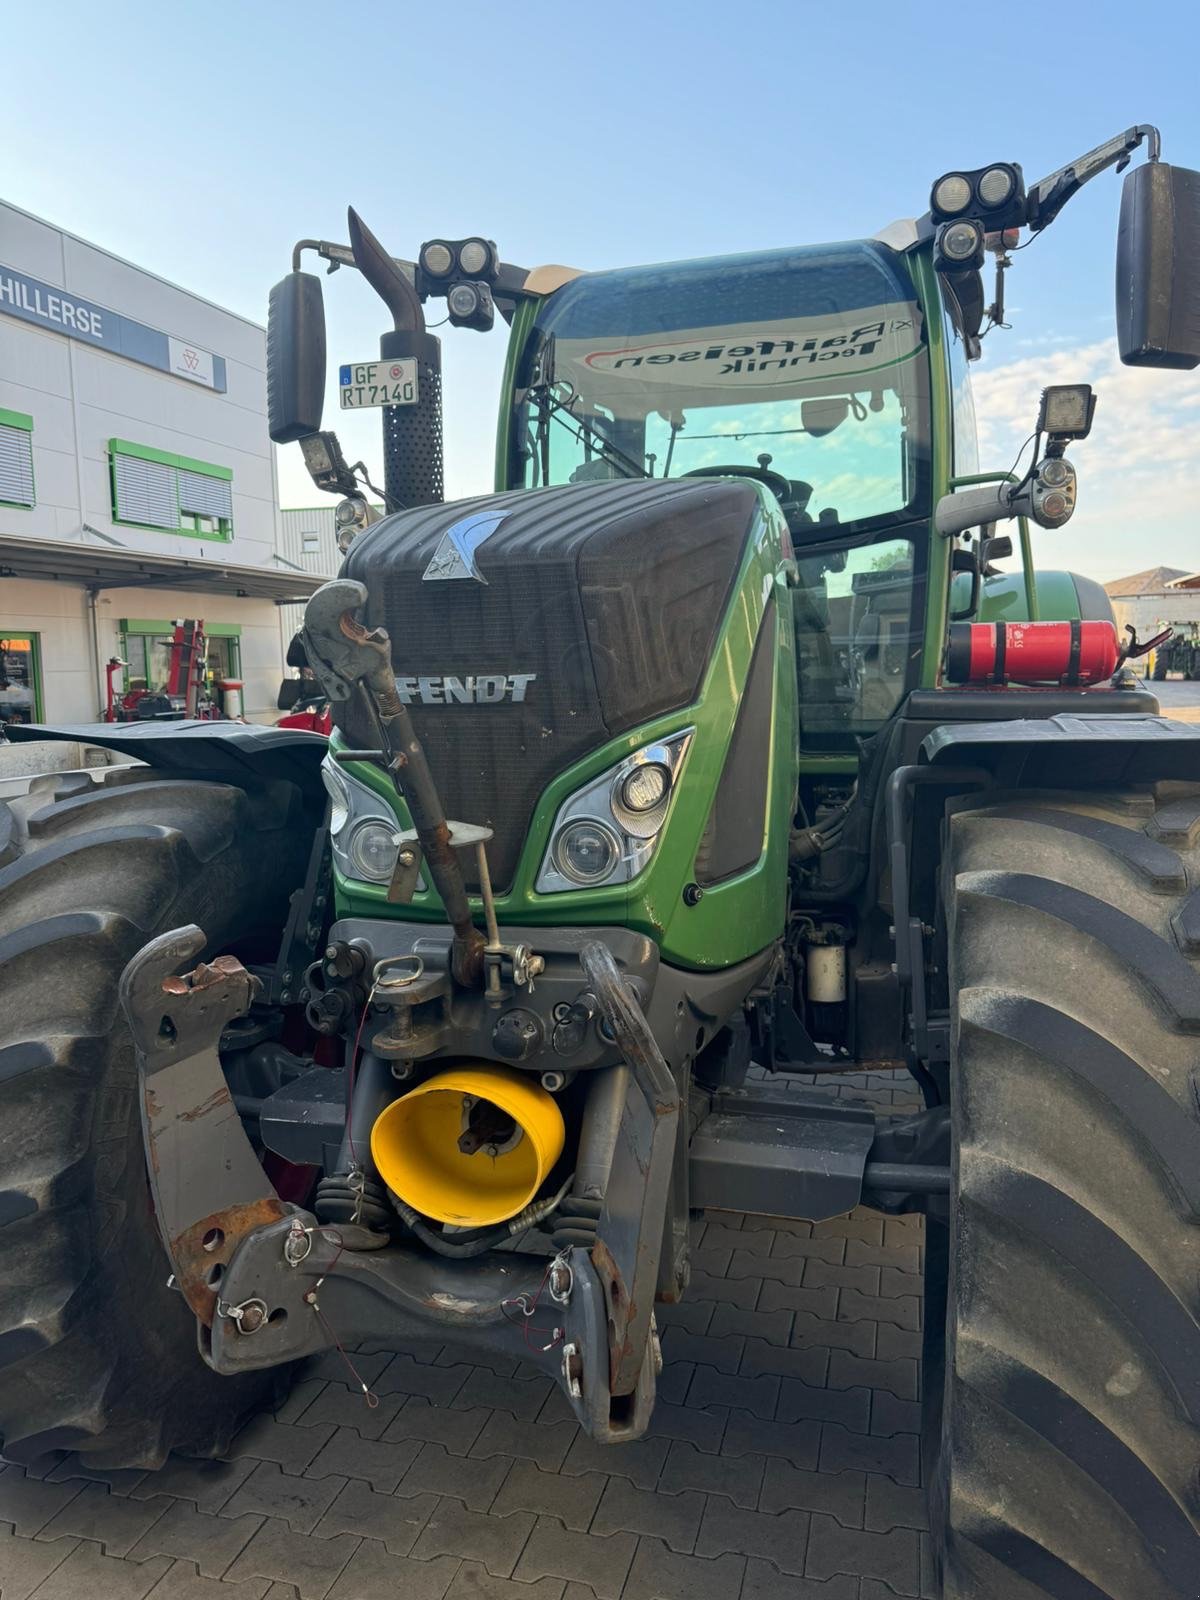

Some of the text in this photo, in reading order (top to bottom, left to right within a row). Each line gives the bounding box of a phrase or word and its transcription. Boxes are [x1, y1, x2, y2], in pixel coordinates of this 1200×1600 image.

[0, 274, 103, 338] HILLERSE
[355, 365, 377, 385] GF
[394, 673, 537, 704] FENDT
